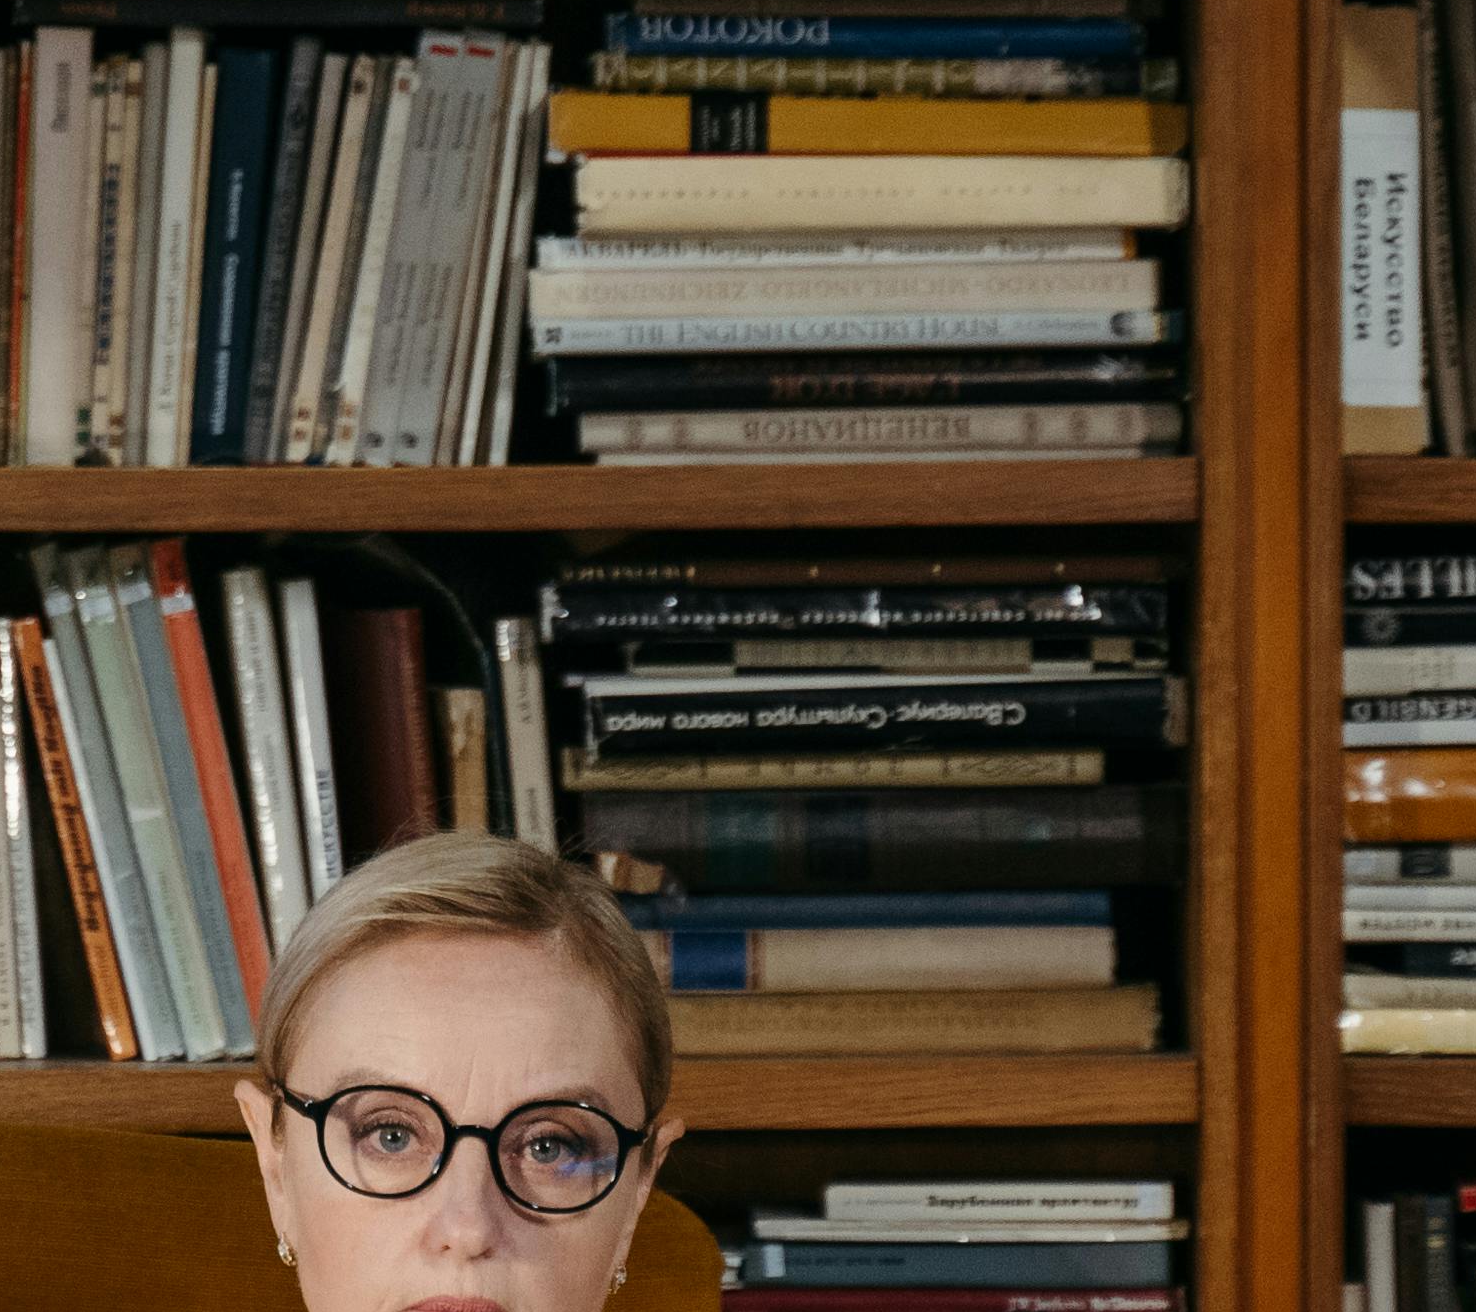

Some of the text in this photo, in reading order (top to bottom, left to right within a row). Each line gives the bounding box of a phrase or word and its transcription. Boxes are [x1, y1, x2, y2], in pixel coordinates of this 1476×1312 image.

[639, 15, 830, 44] РОКОТОВ
[1351, 177, 1375, 344] Беларуси
[1384, 171, 1409, 349] Искусство
[744, 412, 970, 444] ВЕНЕЦИАНОВ
